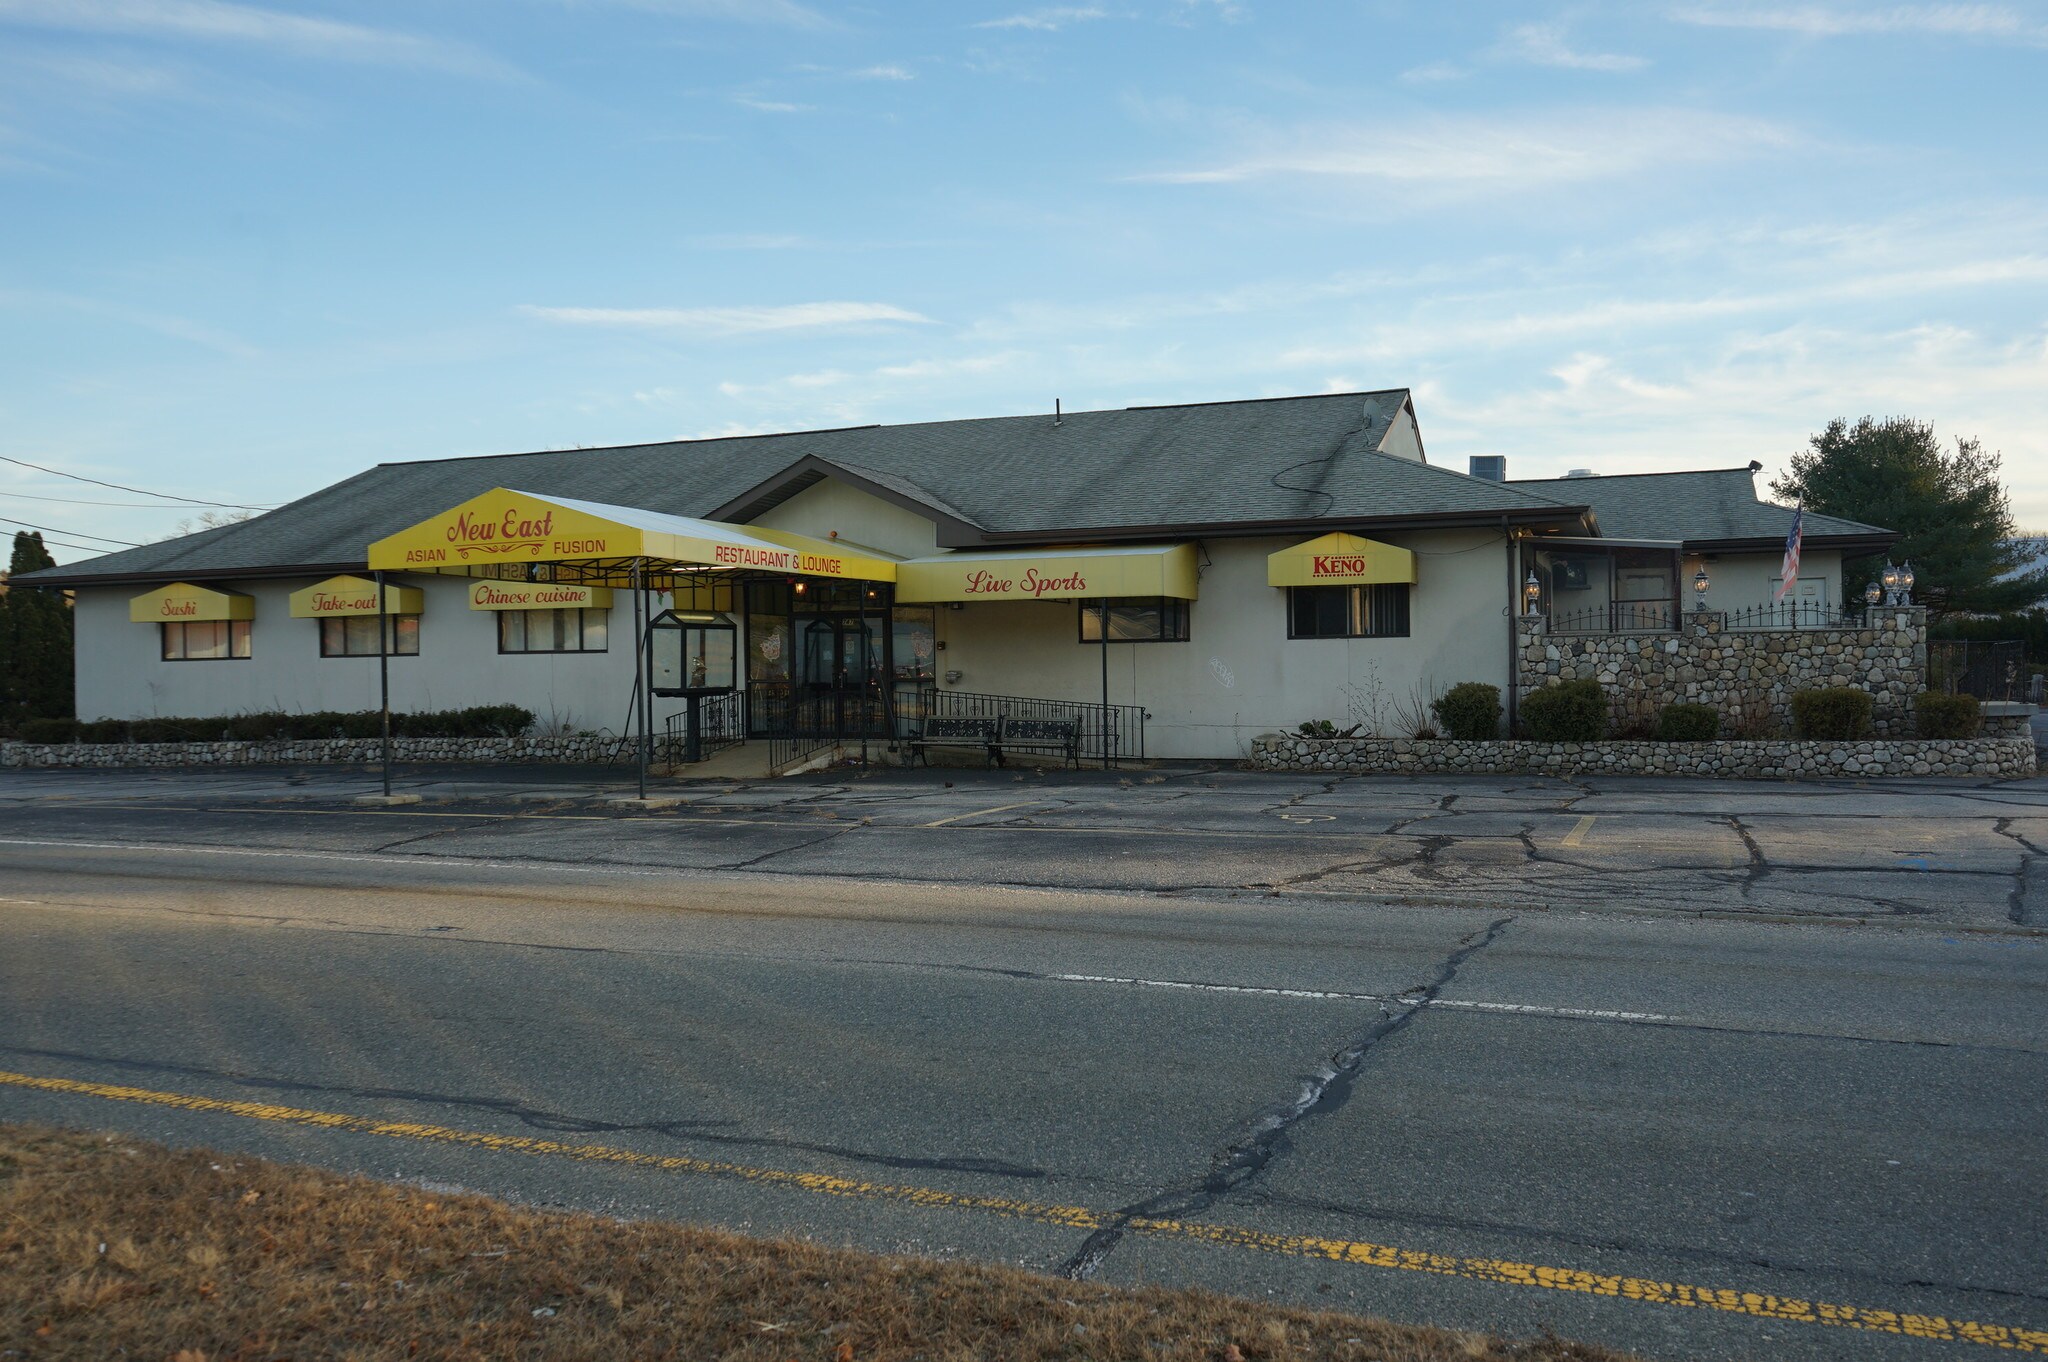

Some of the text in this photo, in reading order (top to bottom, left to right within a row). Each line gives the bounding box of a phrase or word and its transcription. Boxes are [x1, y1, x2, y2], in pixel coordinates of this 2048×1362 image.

[447, 508, 553, 542] New East
[406, 539, 606, 563] ASIAN FUSION
[715, 545, 842, 575] RESTAURANT & LOUNGE
[1313, 556, 1366, 574] KENO
[965, 568, 1087, 598] Live Sports
[312, 592, 377, 612] Take-out
[475, 586, 587, 605] Chinese cuisine
[161, 599, 197, 616] Sushi
